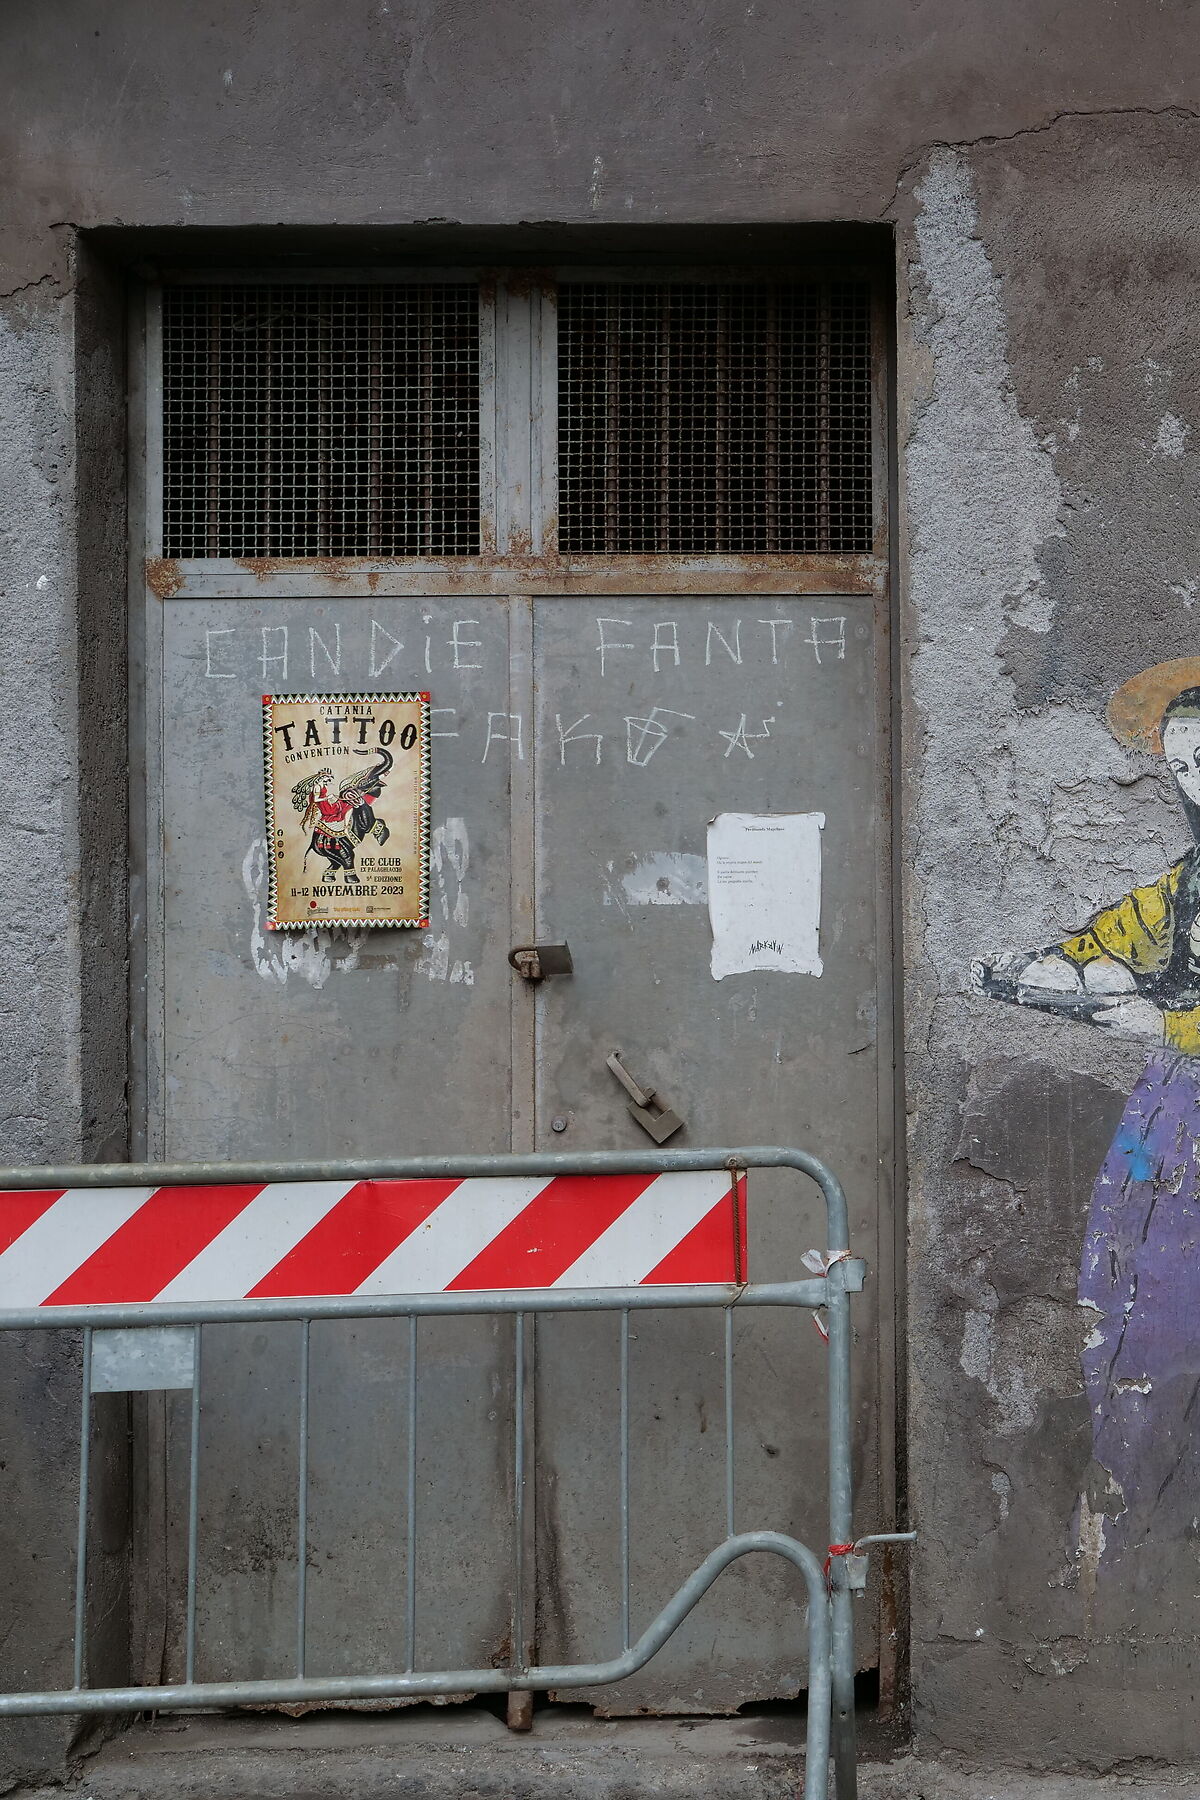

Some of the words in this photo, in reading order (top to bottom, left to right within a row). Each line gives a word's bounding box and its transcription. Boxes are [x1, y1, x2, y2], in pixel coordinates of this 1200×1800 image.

[595, 616, 848, 677] FANTA
[319, 705, 373, 716] CATANIA
[274, 715, 418, 751] TATTOO
[284, 746, 350, 764] CONVENTION
[360, 857, 376, 867] ICE
[377, 857, 401, 867] CLUB
[291, 887, 310, 897] 11-12
[312, 885, 378, 897] NOVEMBRE
[381, 886, 405, 895] 2023
